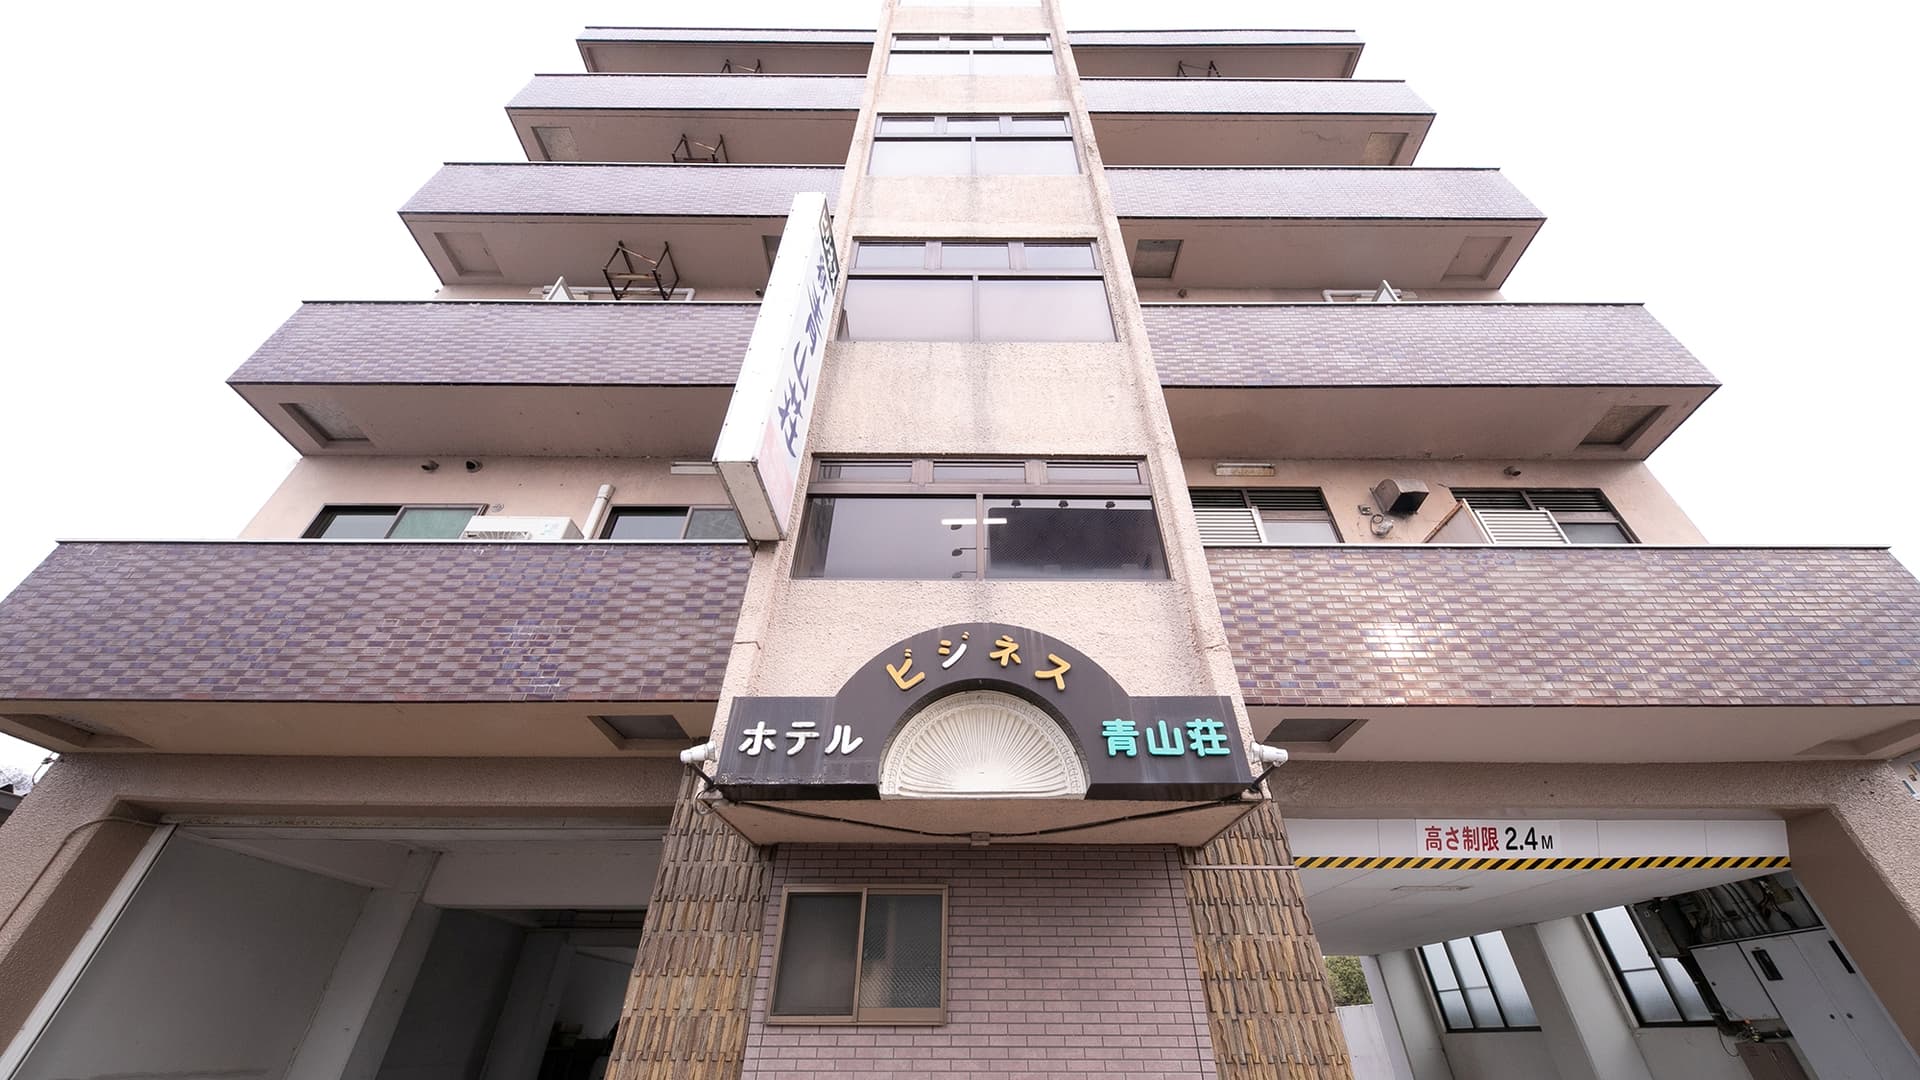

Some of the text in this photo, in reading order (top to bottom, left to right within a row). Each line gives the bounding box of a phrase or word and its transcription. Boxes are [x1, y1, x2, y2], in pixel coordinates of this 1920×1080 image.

[887, 632, 1072, 691] ビジネス
[738, 719, 1230, 757] ホテル 青山荘
[1424, 825, 1500, 852] 高さ制限
